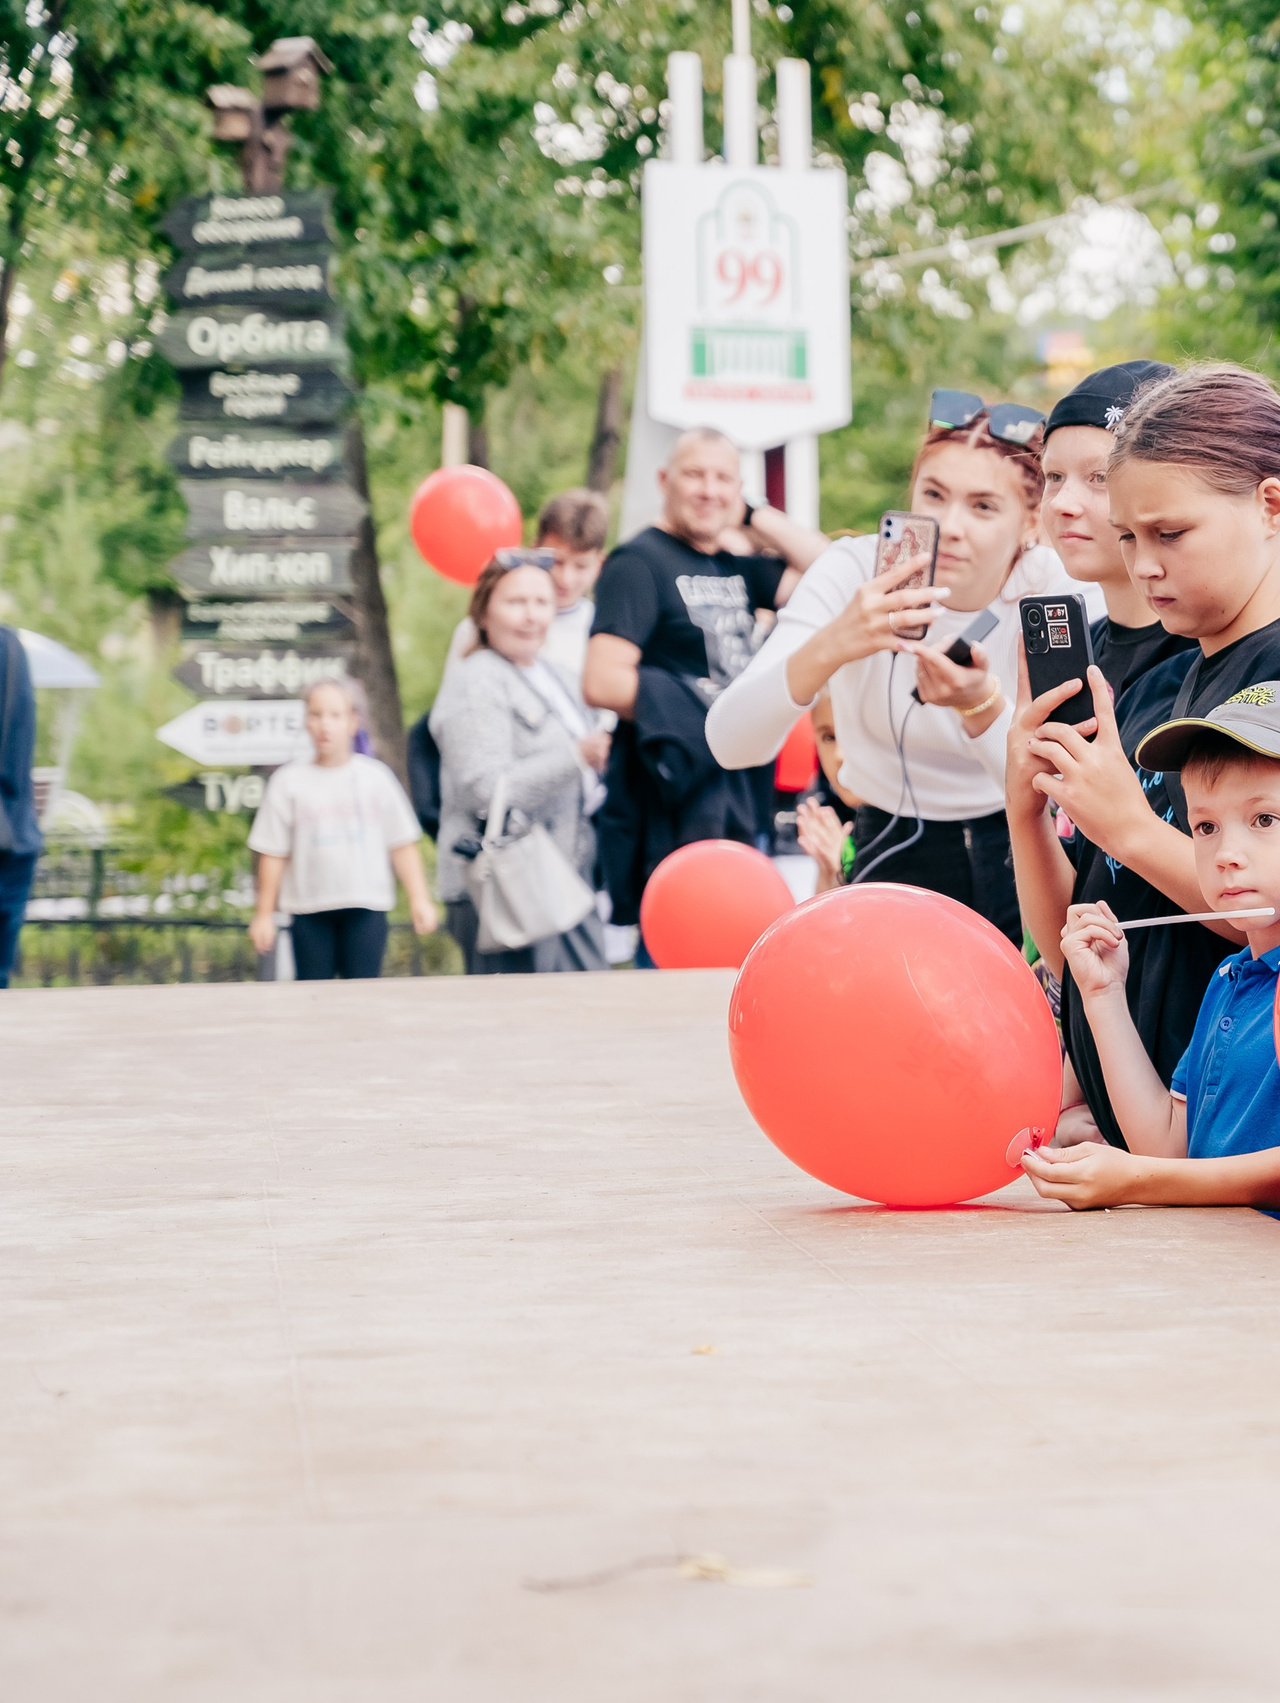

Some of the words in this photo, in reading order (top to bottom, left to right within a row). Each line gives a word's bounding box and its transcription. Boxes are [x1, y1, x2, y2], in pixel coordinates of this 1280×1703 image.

[716, 249, 784, 306] 99
[187, 313, 330, 362] Орбита
[223, 490, 317, 531] Вальс
[209, 545, 331, 586] Хип-хоп
[195, 649, 345, 695] Траффик
[198, 771, 266, 813] Туа
